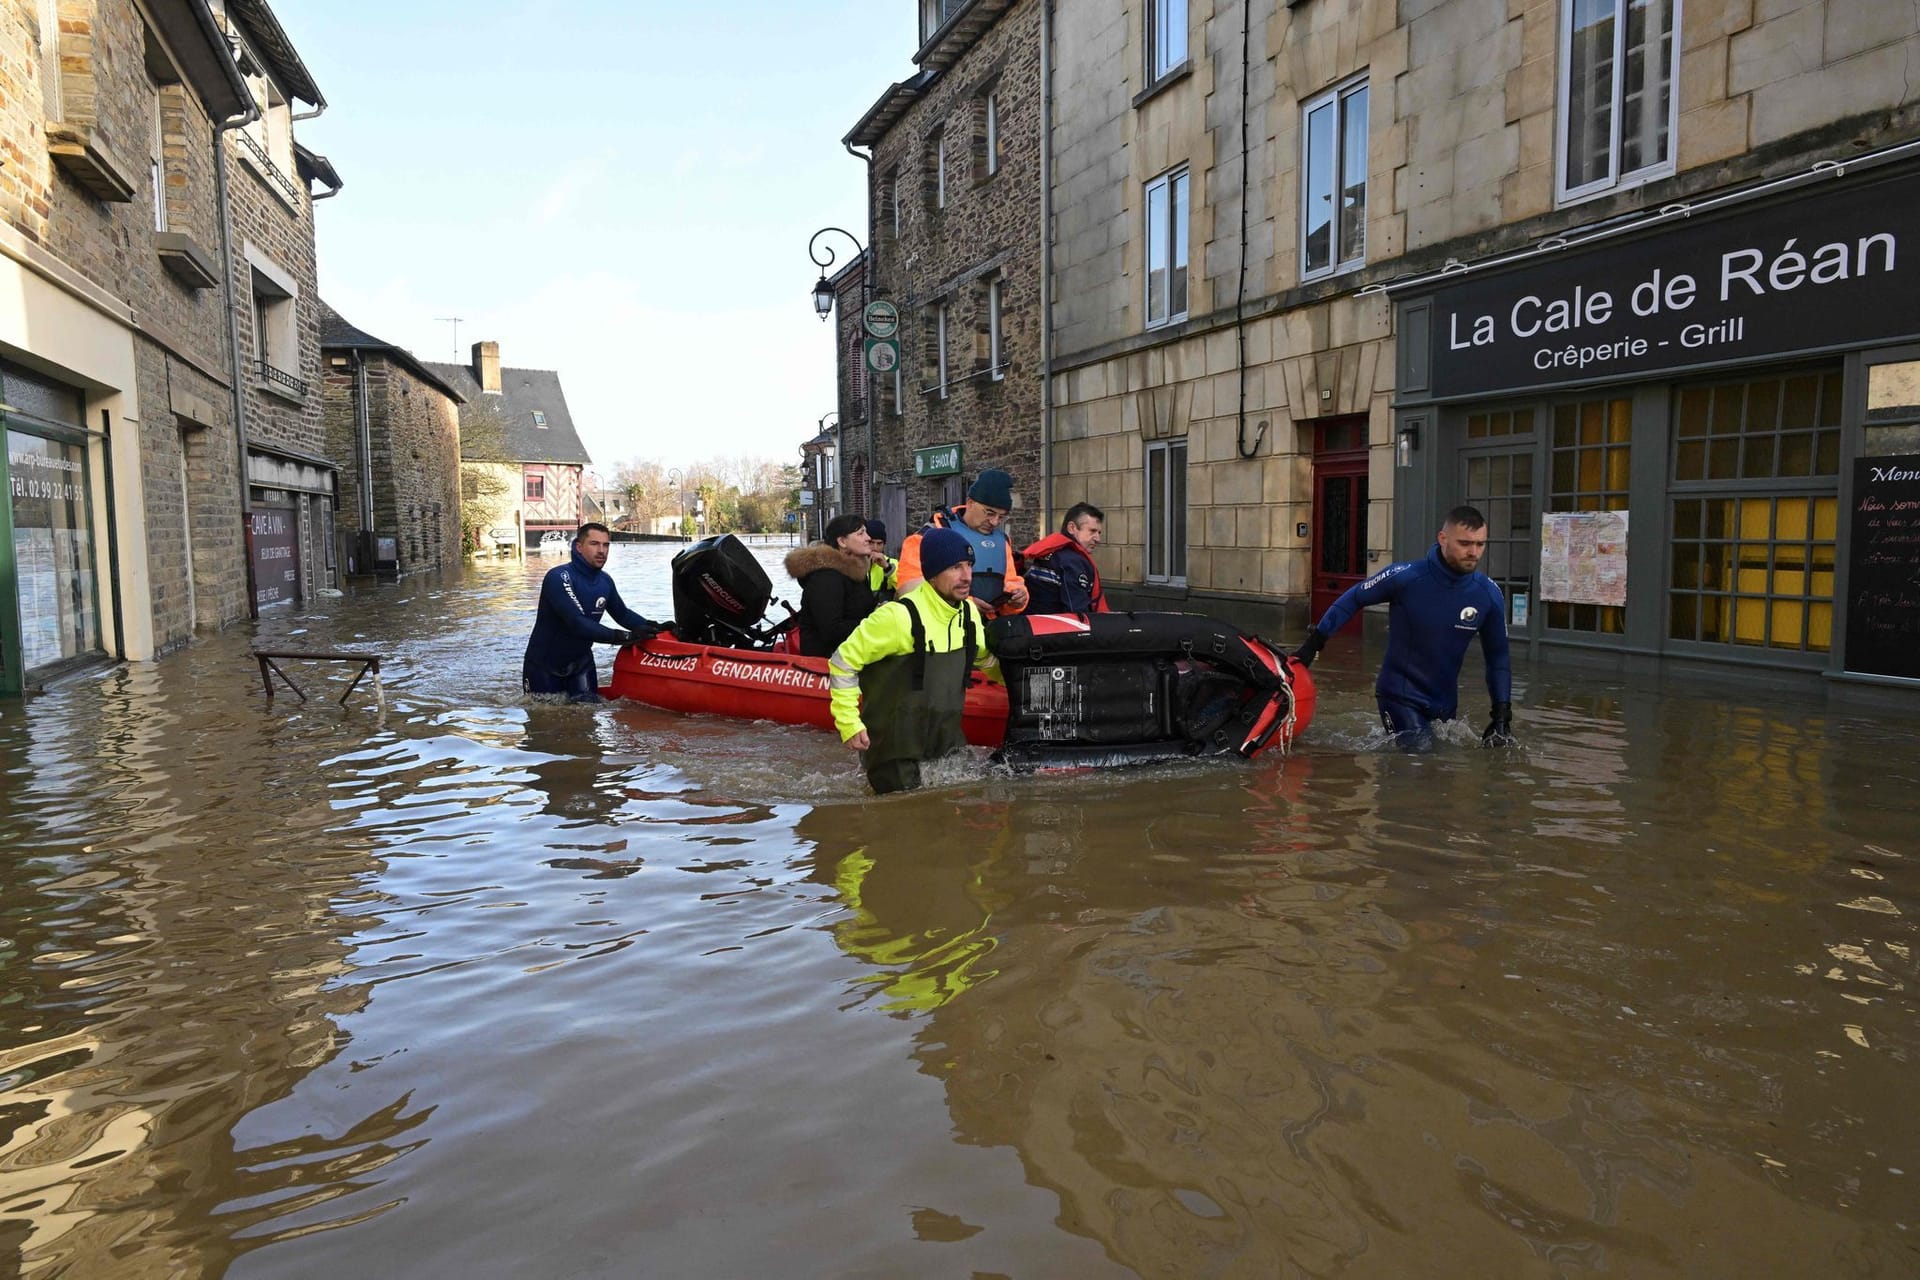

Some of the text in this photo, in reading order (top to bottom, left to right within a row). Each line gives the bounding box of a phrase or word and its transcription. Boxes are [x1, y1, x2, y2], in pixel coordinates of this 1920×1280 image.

[1449, 231, 1897, 350] La Cale de Réan
[1533, 335, 1648, 370] Crêperie
[1680, 317, 1744, 348] Grill
[10, 477, 28, 498] Tél.
[29, 480, 39, 498] 02
[41, 481, 51, 499] 99
[53, 482, 62, 500] 22
[64, 484, 72, 501] 41
[1858, 495, 1886, 512] Nous
[251, 514, 267, 535] CAVE
[273, 516, 283, 535] VIN
[702, 573, 745, 610] MERCURY
[711, 660, 815, 688] GENDARMERIE
